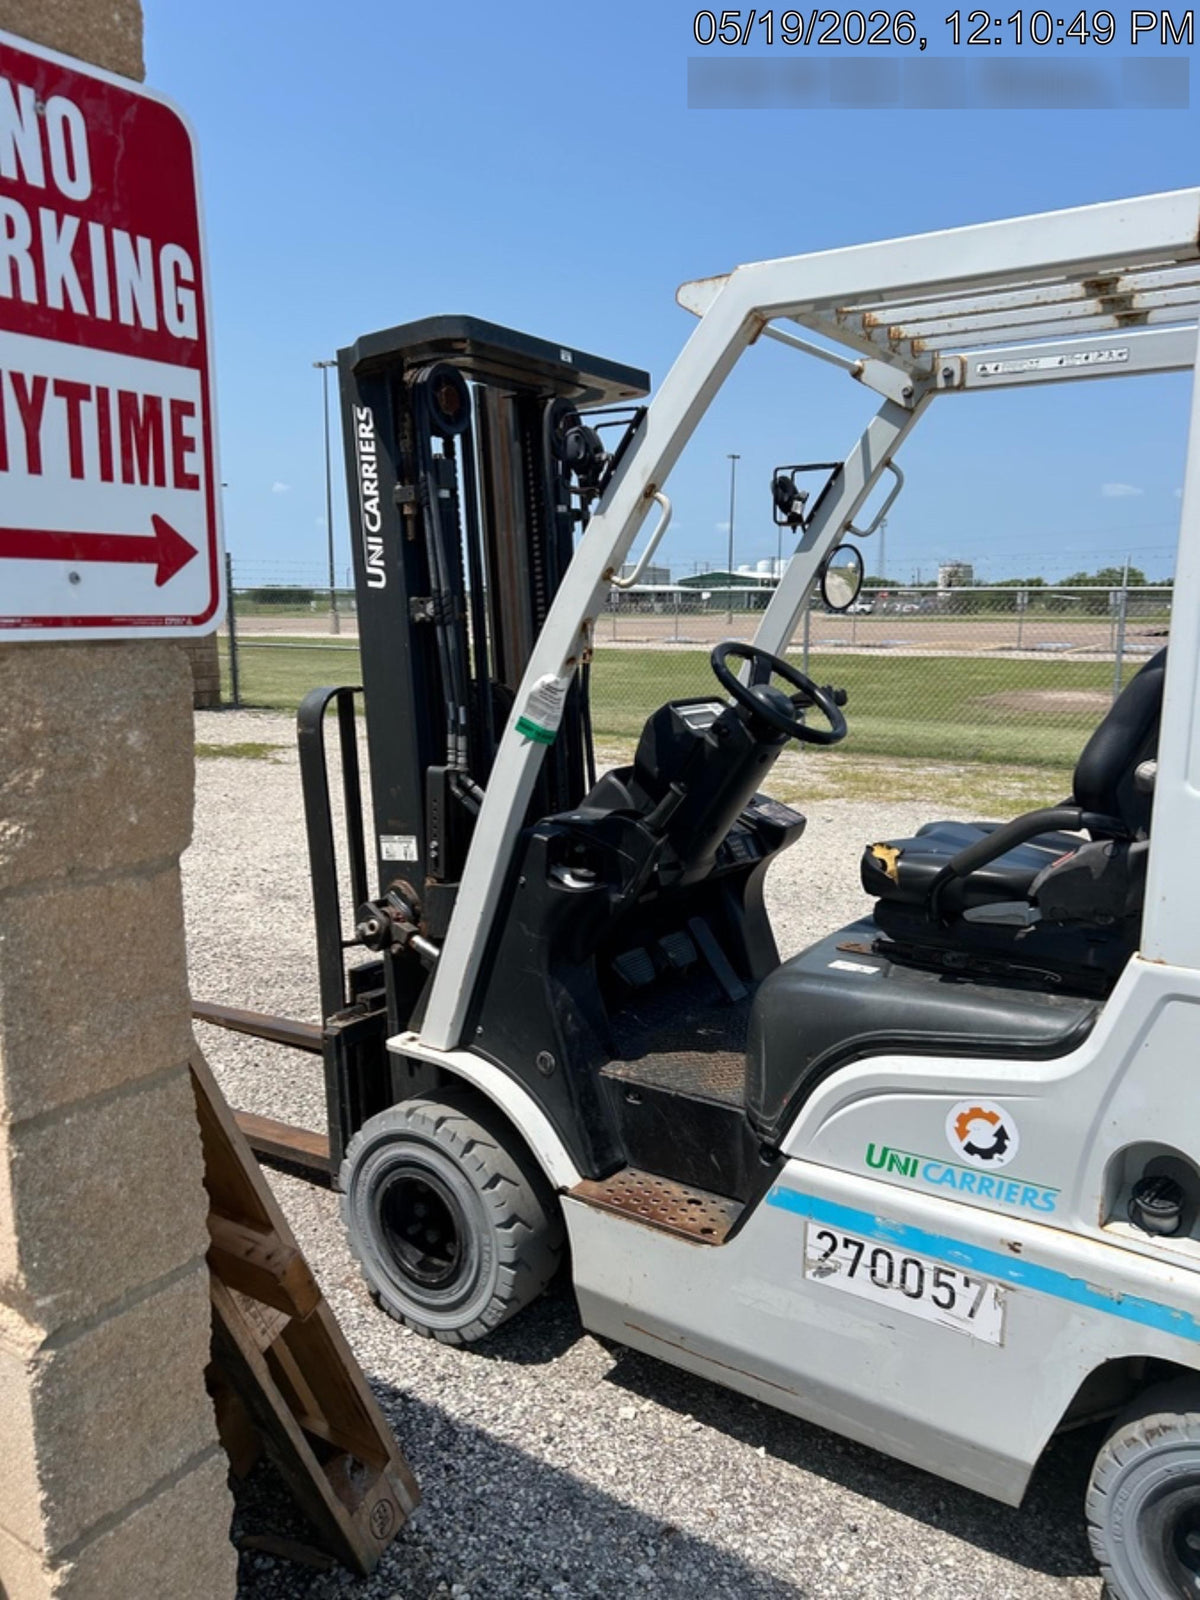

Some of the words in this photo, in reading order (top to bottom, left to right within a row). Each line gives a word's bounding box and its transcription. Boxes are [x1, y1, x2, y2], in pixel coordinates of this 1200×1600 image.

[0, 75, 92, 202] NO
[0, 194, 199, 341] RKING
[0, 368, 200, 491] YTIME
[816, 1230, 988, 1319] 270057
